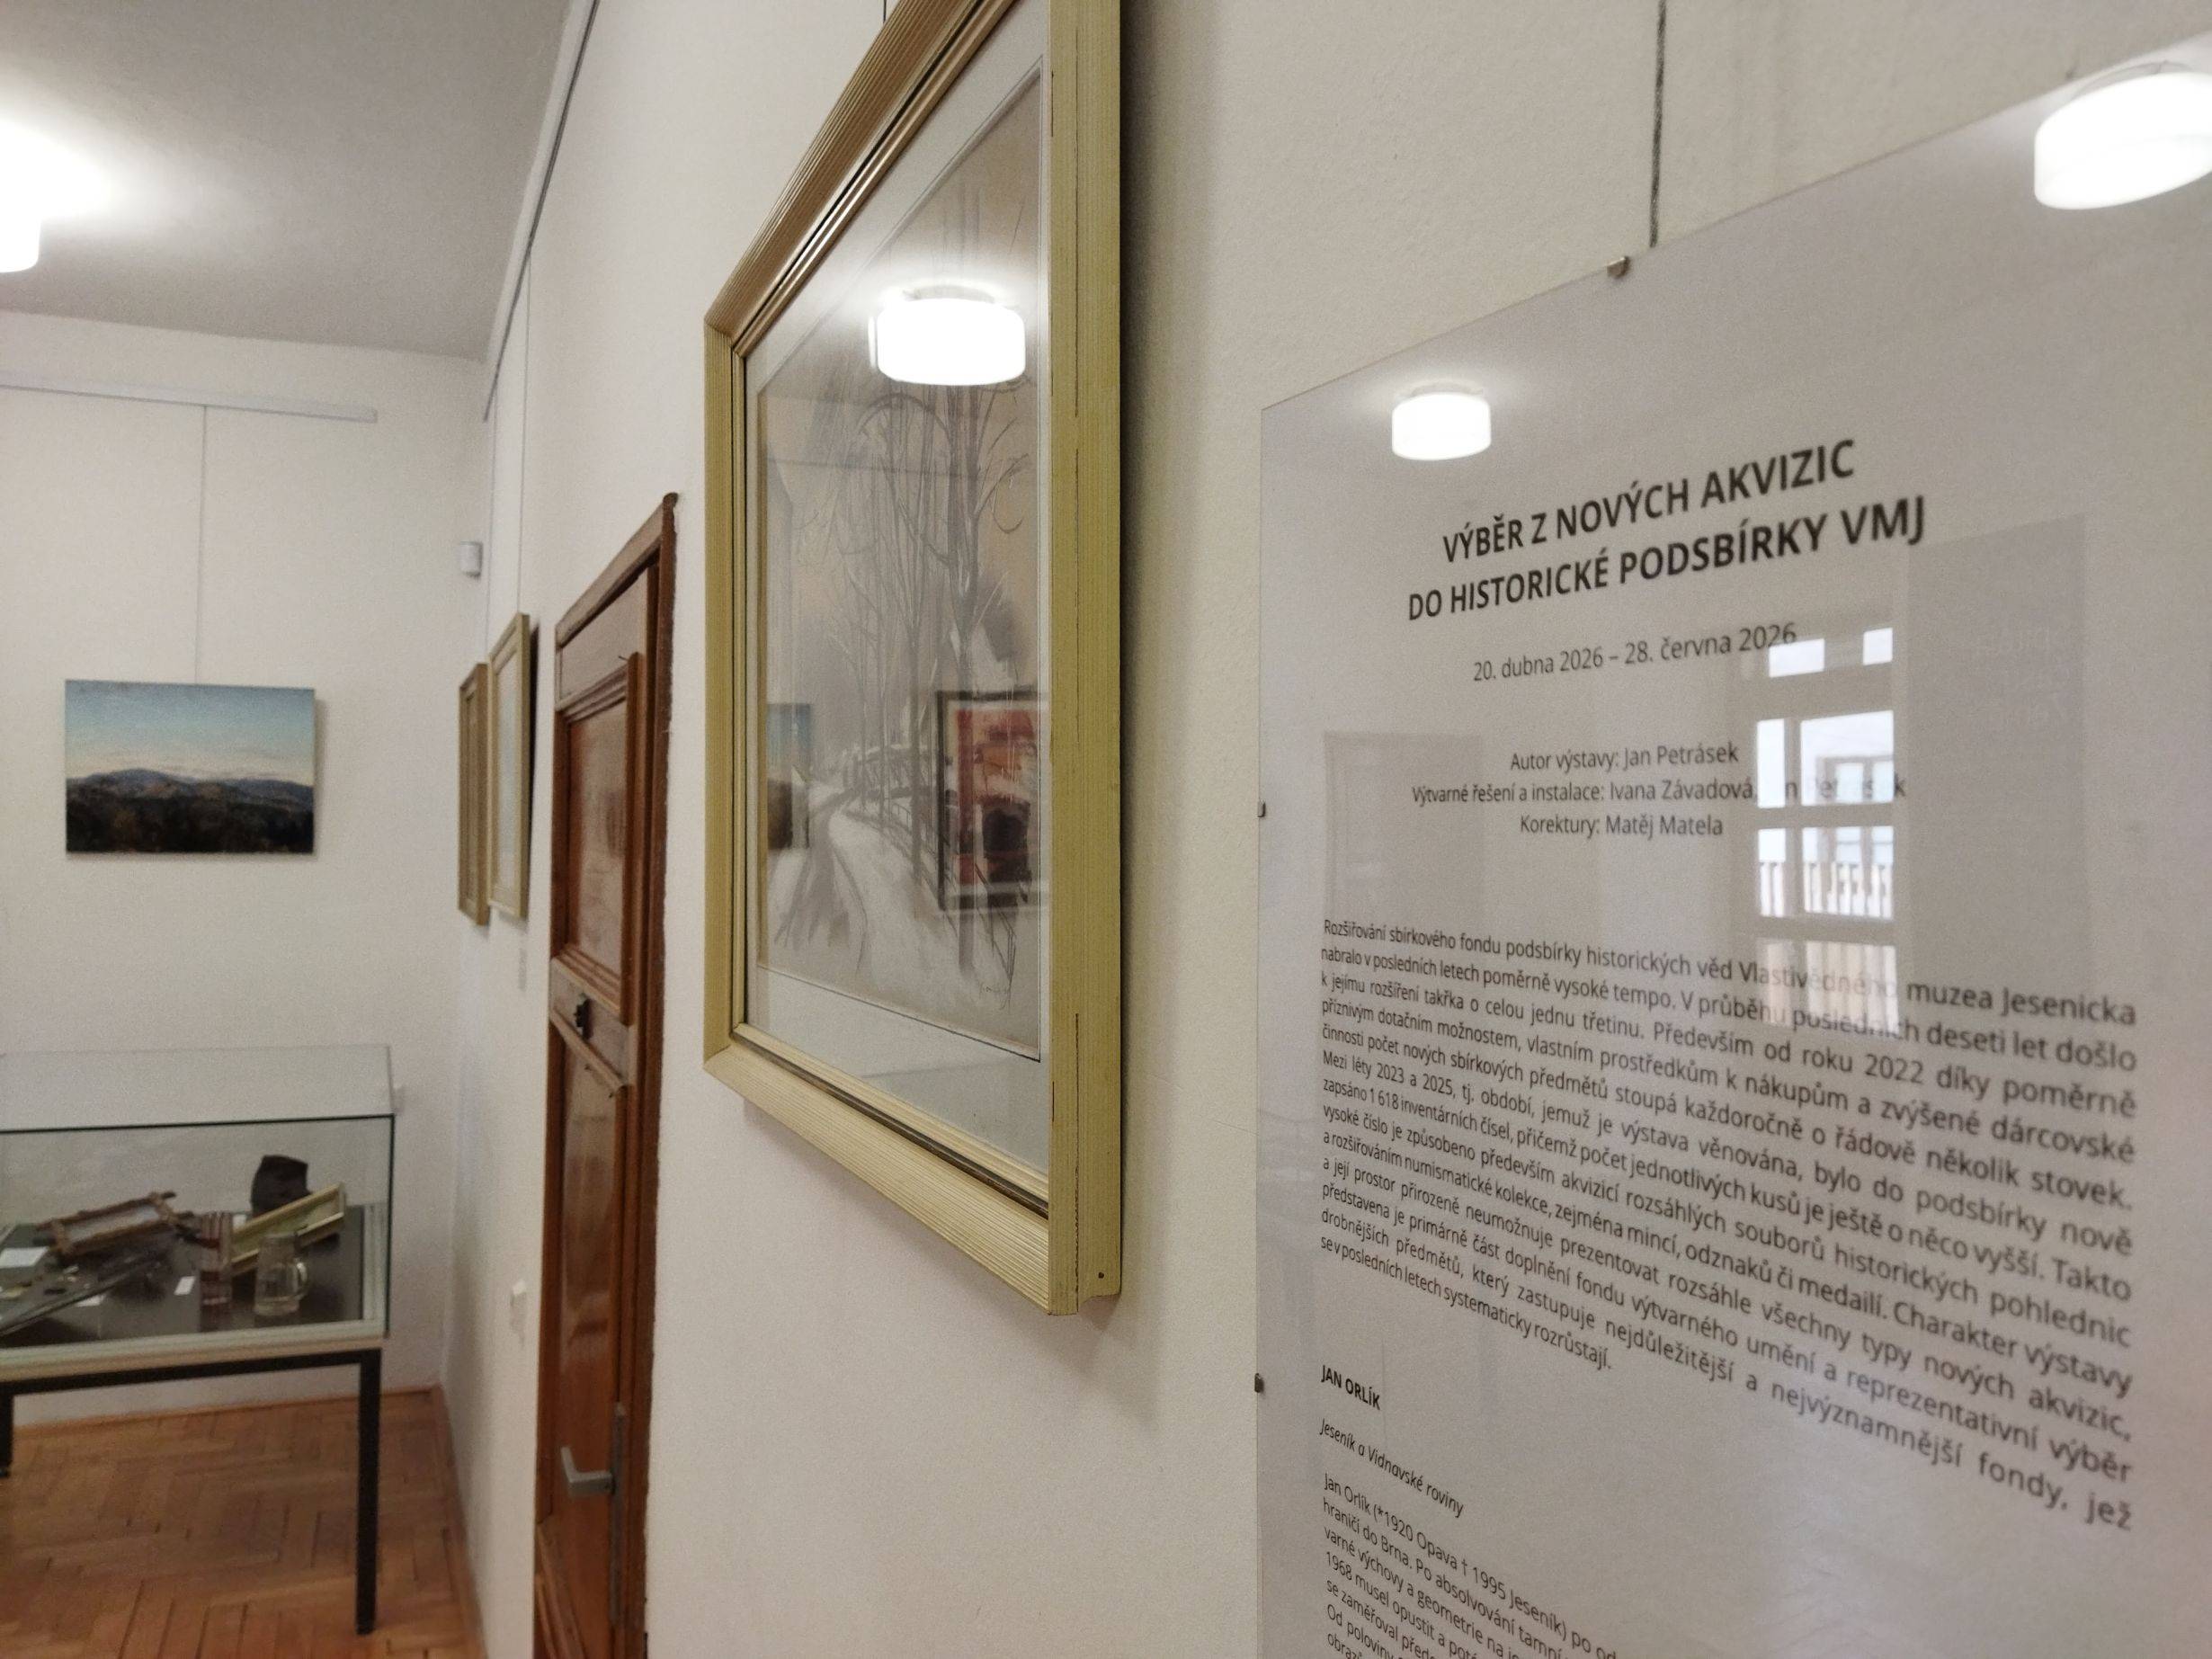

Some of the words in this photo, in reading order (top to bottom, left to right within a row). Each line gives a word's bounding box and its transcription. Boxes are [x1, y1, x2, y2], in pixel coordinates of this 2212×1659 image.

[1408, 588, 1442, 621] DO
[1449, 546, 1609, 614] HISTORICKÉ
[1619, 512, 1829, 585] PODSBÍRKY
[1839, 494, 1925, 547] VMJ
[1441, 513, 1524, 563] VÝBĚR
[1530, 511, 1548, 545] Z
[1556, 477, 1689, 540] NOVÝCH
[1699, 438, 1855, 509] AKVIZIC
[1473, 660, 1496, 682] 20.
[1501, 655, 1554, 679] dubna
[1559, 646, 1603, 673] 2026
[1624, 640, 1653, 665] 28.
[1660, 634, 1732, 661] června
[1738, 620, 1798, 652] 2026
[1412, 783, 1468, 807] Výtvarné
[1472, 782, 1515, 803] řešení
[1518, 787, 1527, 802] a
[1531, 780, 1604, 802] instalace:
[1610, 781, 1655, 800] Ivana
[1510, 753, 1552, 771] Autor
[1556, 748, 1619, 774] výstavy:
[1622, 747, 1651, 772] Jan
[1656, 741, 1738, 765] Petrásek
[1520, 814, 1600, 840] Korektury:
[1606, 814, 1654, 841] Matěj
[1659, 814, 1723, 836] Matela
[1321, 946, 1362, 965] nabralo
[1373, 954, 1437, 976] posledních
[1439, 959, 1479, 982] letech
[1483, 968, 1550, 992] poměrně
[1553, 978, 1609, 1000] vysoké
[1612, 984, 1675, 1012] tempo.
[1926, 1021, 2006, 1054] deseti
[2012, 1030, 2047, 1060] let
[2056, 1038, 2136, 1072] došlo
[1331, 972, 1365, 994] jejímu
[1369, 980, 1419, 1002] rozšíření
[1423, 988, 1464, 1010] takřka
[1485, 997, 1524, 1020] celou
[1530, 1003, 1574, 1028] jednu
[1582, 1011, 1644, 1039] třetinu.
[1654, 1021, 1753, 1057] Především
[1802, 1046, 1852, 1074] roku
[1864, 1053, 1923, 1084] 2022
[1935, 1064, 1990, 1101] díky
[2002, 1079, 2136, 1119] poměrně
[1388, 925, 1456, 950] sbírkového
[1459, 932, 1501, 955] fondu
[1505, 939, 1582, 968] podsbírky
[1586, 944, 1690, 978] historických
[1697, 957, 1733, 980] věd
[1906, 982, 1993, 1010] muzea
[2000, 987, 2136, 1026] Jesenicka
[1322, 997, 1374, 1023] příznivým
[1378, 1007, 1432, 1033] dotačním
[1437, 1021, 1521, 1052] možnostem,
[1526, 1034, 1593, 1063] vlastním
[1600, 1050, 1717, 1086] prostředkům
[1744, 1073, 1849, 1110] nákupům
[1880, 1100, 1980, 1137] zvýšené
[1990, 1115, 2135, 1164] dárcovské
[1322, 1022, 1363, 1047] činnosti
[1367, 1034, 1399, 1055] počet
[1403, 1043, 1446, 1066] nových
[1449, 1050, 1523, 1083] sbírkových
[1529, 1066, 1608, 1100] předmětů
[1615, 1086, 1677, 1116] stoupá
[1685, 1095, 1803, 1141] každoročně
[1835, 1125, 1915, 1164] řádově
[1926, 1147, 2019, 1187] několik
[2031, 1171, 2131, 1210] stovek.
[1323, 1048, 1347, 1069] Mezi
[1351, 1054, 1372, 1080] léty
[1377, 1062, 1405, 1084] 2023
[1423, 1073, 1455, 1099] 2025,
[1480, 1087, 1534, 1119] období,
[1540, 1100, 1590, 1129] jemuž
[1620, 1119, 1689, 1152] výstava
[1698, 1137, 1803, 1182] věnována,
[1815, 1160, 1861, 1193] bylo
[1915, 1190, 2047, 1243] podsbírky
[2060, 1222, 2132, 1257] nově
[1323, 1078, 1367, 1102] zapsáno
[1400, 1095, 1477, 1131] inventárních
[1480, 1116, 1513, 1144] čísel,
[1516, 1127, 1576, 1158] přičemž
[1580, 1146, 1628, 1172] počet
[1628, 1154, 1745, 1201] jednotlivých
[1750, 1182, 1800, 1216] kusů
[1827, 1202, 1883, 1238] ještě
[1908, 1226, 1968, 1260] něco
[1973, 1244, 2044, 1279] vyšší.
[2052, 1257, 2132, 1302] Takto
[1323, 1104, 1359, 1127] vysoké
[1362, 1111, 1387, 1135] číslo
[1406, 1128, 1476, 1161] způsobeno
[1480, 1147, 1555, 1184] především
[1561, 1171, 1619, 1203] akvizicí
[1626, 1191, 1726, 1234] rozsáhlých
[1735, 1220, 1824, 1262] souborů
[1834, 1243, 1978, 1304] historických
[1990, 1291, 2129, 1348] pohlednic
[1322, 1182, 1389, 1218] představena
[1408, 1215, 1467, 1248] primárně
[1472, 1233, 1500, 1261] část
[1504, 1246, 1571, 1286] doplnění
[1575, 1271, 1624, 1307] fondu
[1631, 1295, 1738, 1347] výtvarného
[1746, 1336, 1815, 1373] umění
[1847, 1370, 2038, 1450] reprezentativní
[2049, 1439, 2132, 1482] výběr
[1331, 1133, 1402, 1167] rozšiřováním
[1404, 1156, 1493, 1196] numismatické
[1494, 1180, 1552, 1218] kolekce,
[1555, 1203, 1623, 1238] zejména
[1627, 1226, 1681, 1260] mincí,
[1684, 1244, 1772, 1284] odznaků
[1797, 1276, 1886, 1319] medailí.
[1893, 1300, 2018, 1358] Charakter
[2024, 1343, 2132, 1399] výstavy
[1354, 1167, 1396, 1192] prostor
[1400, 1182, 1459, 1215] přirozeně
[1560, 1237, 1659, 1285] prezentovat
[1668, 1273, 1752, 1315] rozsáhle
[1761, 1301, 1851, 1352] všechny
[1924, 1355, 2014, 1400] nových
[2028, 1387, 2131, 1442] akvizic,
[1320, 1364, 1342, 1389] JAN
[1344, 1378, 1380, 1411] ORLÍK
[1321, 1208, 1389, 1247] drobnějších
[1396, 1236, 1464, 1279] předmětů,
[1472, 1263, 1509, 1298] který
[1517, 1285, 1595, 1331] zastupuje
[1605, 1320, 1735, 1382] nejdůležitější
[1771, 1383, 1962, 1467] nejvýznamnější
[1978, 1451, 2067, 1510] fondy,
[2085, 1496, 2131, 1530] jež
[1318, 1417, 1356, 1452] Jeseník
[1368, 1445, 1423, 1493] Vidnavské
[1425, 1483, 1464, 1519] roviny
[1324, 1472, 1342, 1496] Jan
[1343, 1485, 1370, 1515] Orlík
[1416, 1530, 1458, 1571] Opava
[1472, 1566, 1506, 1601] 1995
[1509, 1589, 1566, 1642] Jeseník)
